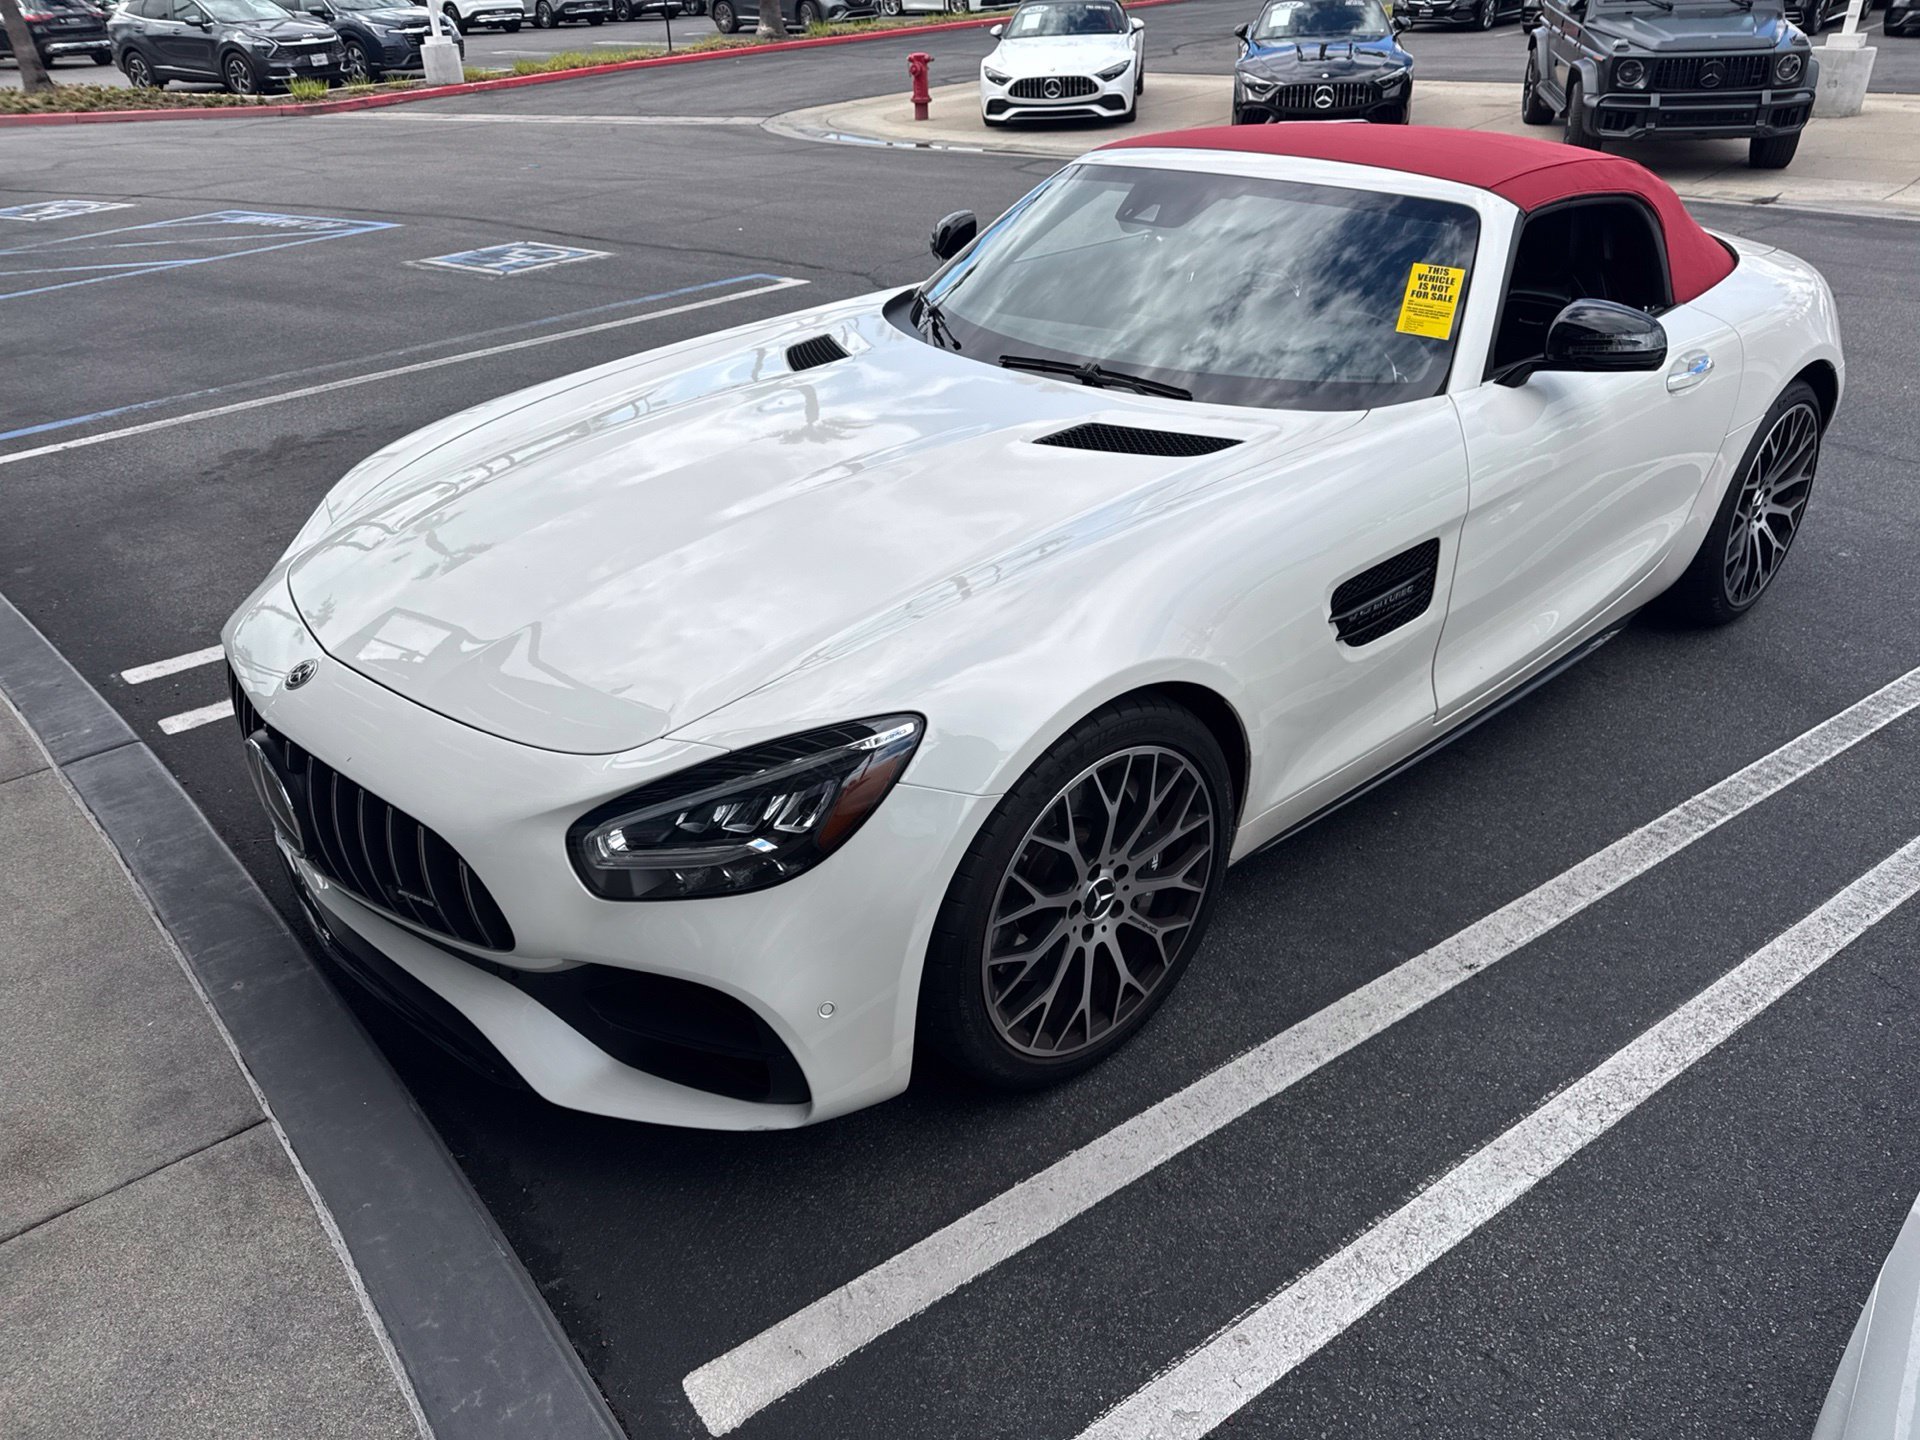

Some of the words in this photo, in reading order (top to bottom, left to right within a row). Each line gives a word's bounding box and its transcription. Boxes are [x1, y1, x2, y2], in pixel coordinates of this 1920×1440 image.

[1427, 266, 1450, 276] THIS
[1417, 273, 1456, 286] VEHICLE
[1418, 282, 1429, 290] IS
[1430, 284, 1450, 293] NOT
[1410, 289, 1429, 299] FOR
[1430, 292, 1453, 303] SALE
